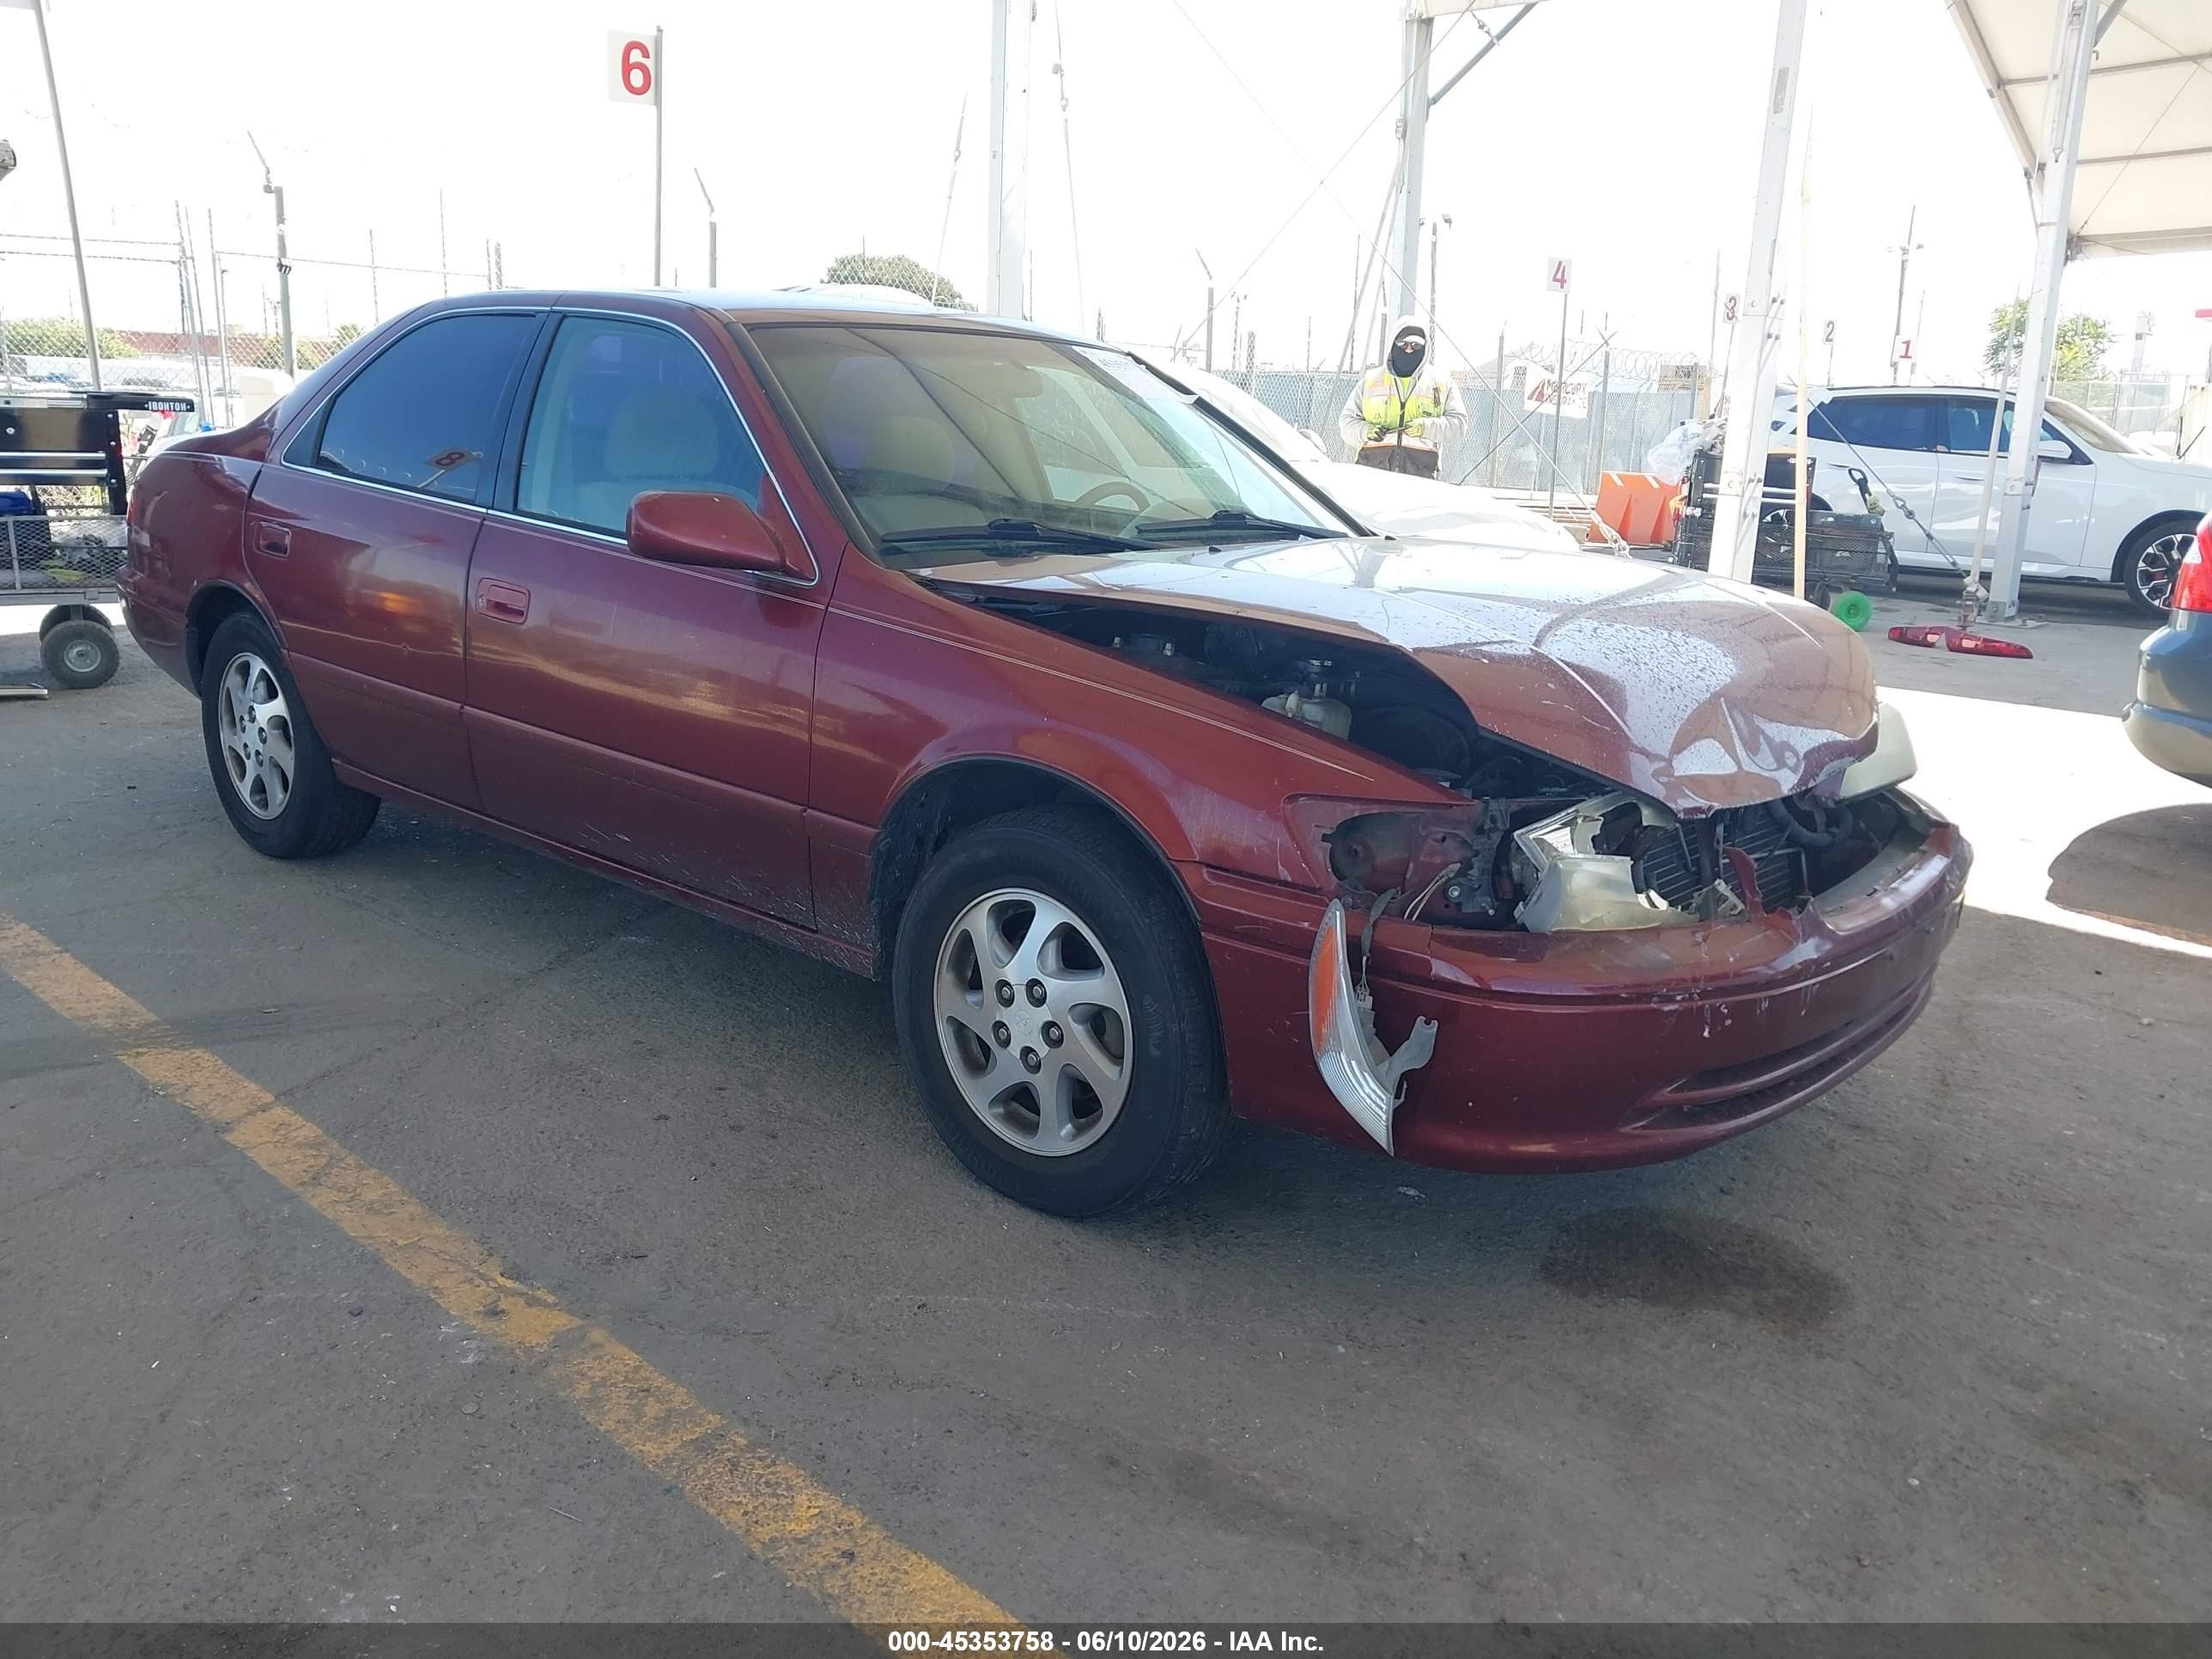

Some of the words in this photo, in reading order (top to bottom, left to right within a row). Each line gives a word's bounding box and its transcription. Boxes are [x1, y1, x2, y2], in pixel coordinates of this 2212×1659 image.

[621, 40, 652, 95] 6
[1552, 260, 1567, 289] 4
[1725, 295, 1738, 321] 3
[1825, 319, 1835, 343] 2
[1899, 339, 1913, 359] 1
